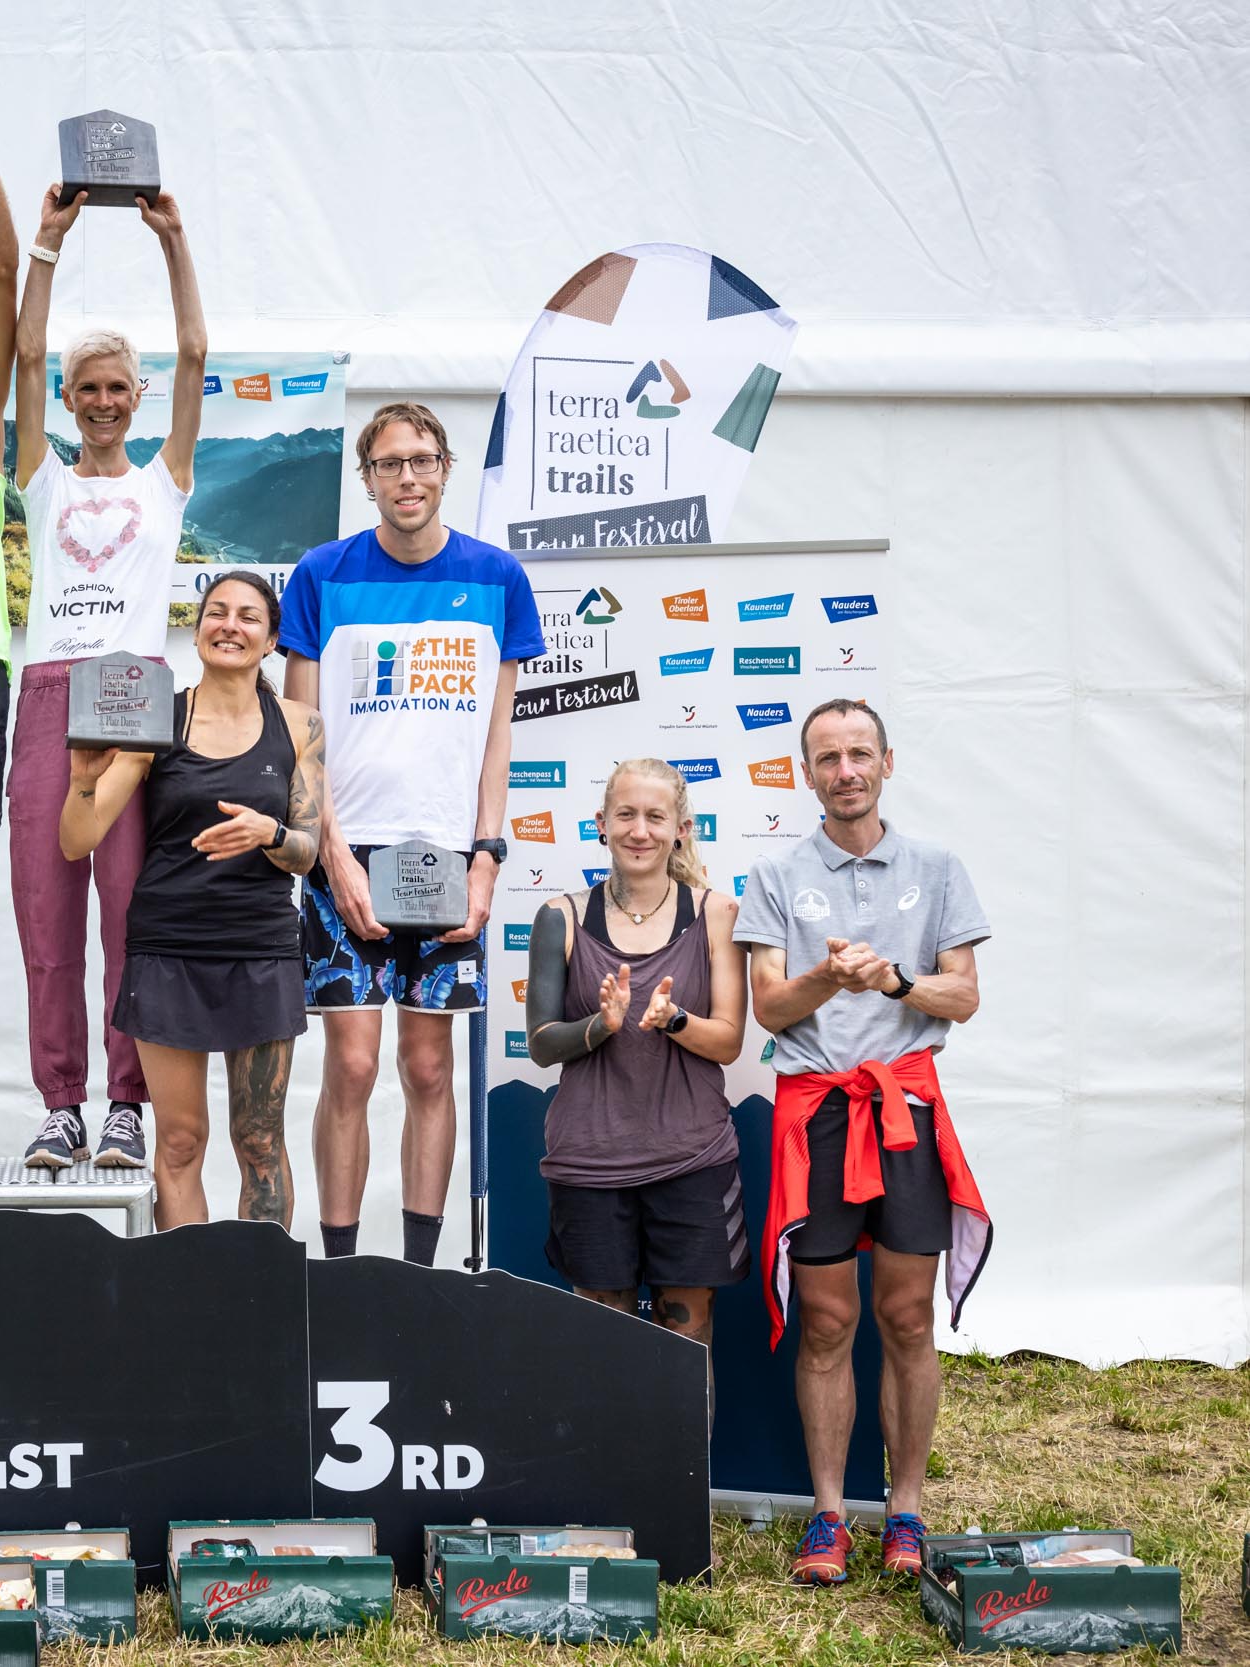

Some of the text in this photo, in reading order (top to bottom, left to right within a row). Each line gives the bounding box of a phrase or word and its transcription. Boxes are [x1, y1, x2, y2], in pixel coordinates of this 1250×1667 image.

[287, 380, 321, 388] Kaunertal
[546, 390, 620, 419] terra
[546, 427, 651, 457] raetica
[546, 464, 635, 496] trails
[594, 503, 703, 548] Festival
[63, 583, 114, 597] FASHION
[673, 596, 699, 605] Tiroler
[744, 602, 785, 611] Kaunertal
[831, 600, 870, 609] Nauders
[49, 600, 125, 618] VICTIM
[668, 604, 704, 613] Oberland
[543, 631, 594, 649] etica
[410, 637, 476, 657] #THE
[410, 660, 476, 671] RUNNING
[522, 654, 583, 674] trails
[665, 656, 706, 666] Kaunertal
[738, 656, 786, 666] Reschenpass
[409, 674, 476, 696] PACK
[103, 689, 129, 698] trails
[555, 675, 635, 712] Festival
[97, 699, 147, 713] Tour Festival
[455, 699, 477, 712] AG
[514, 695, 550, 717] our
[746, 708, 784, 717] Nauders
[677, 763, 714, 772] Nauders
[759, 763, 786, 771] Tiroler
[509, 771, 552, 779] Reschenpass
[754, 771, 790, 779] Oberland
[522, 818, 546, 826] Tiroler
[517, 826, 551, 834] Oberland
[401, 875, 425, 883] trails
[395, 884, 443, 898] Tour Festival
[313, 1380, 485, 1492] 3RD
[205, 1568, 273, 1607] Recla
[456, 1567, 533, 1606] Recla
[975, 1577, 1052, 1620] Recla
